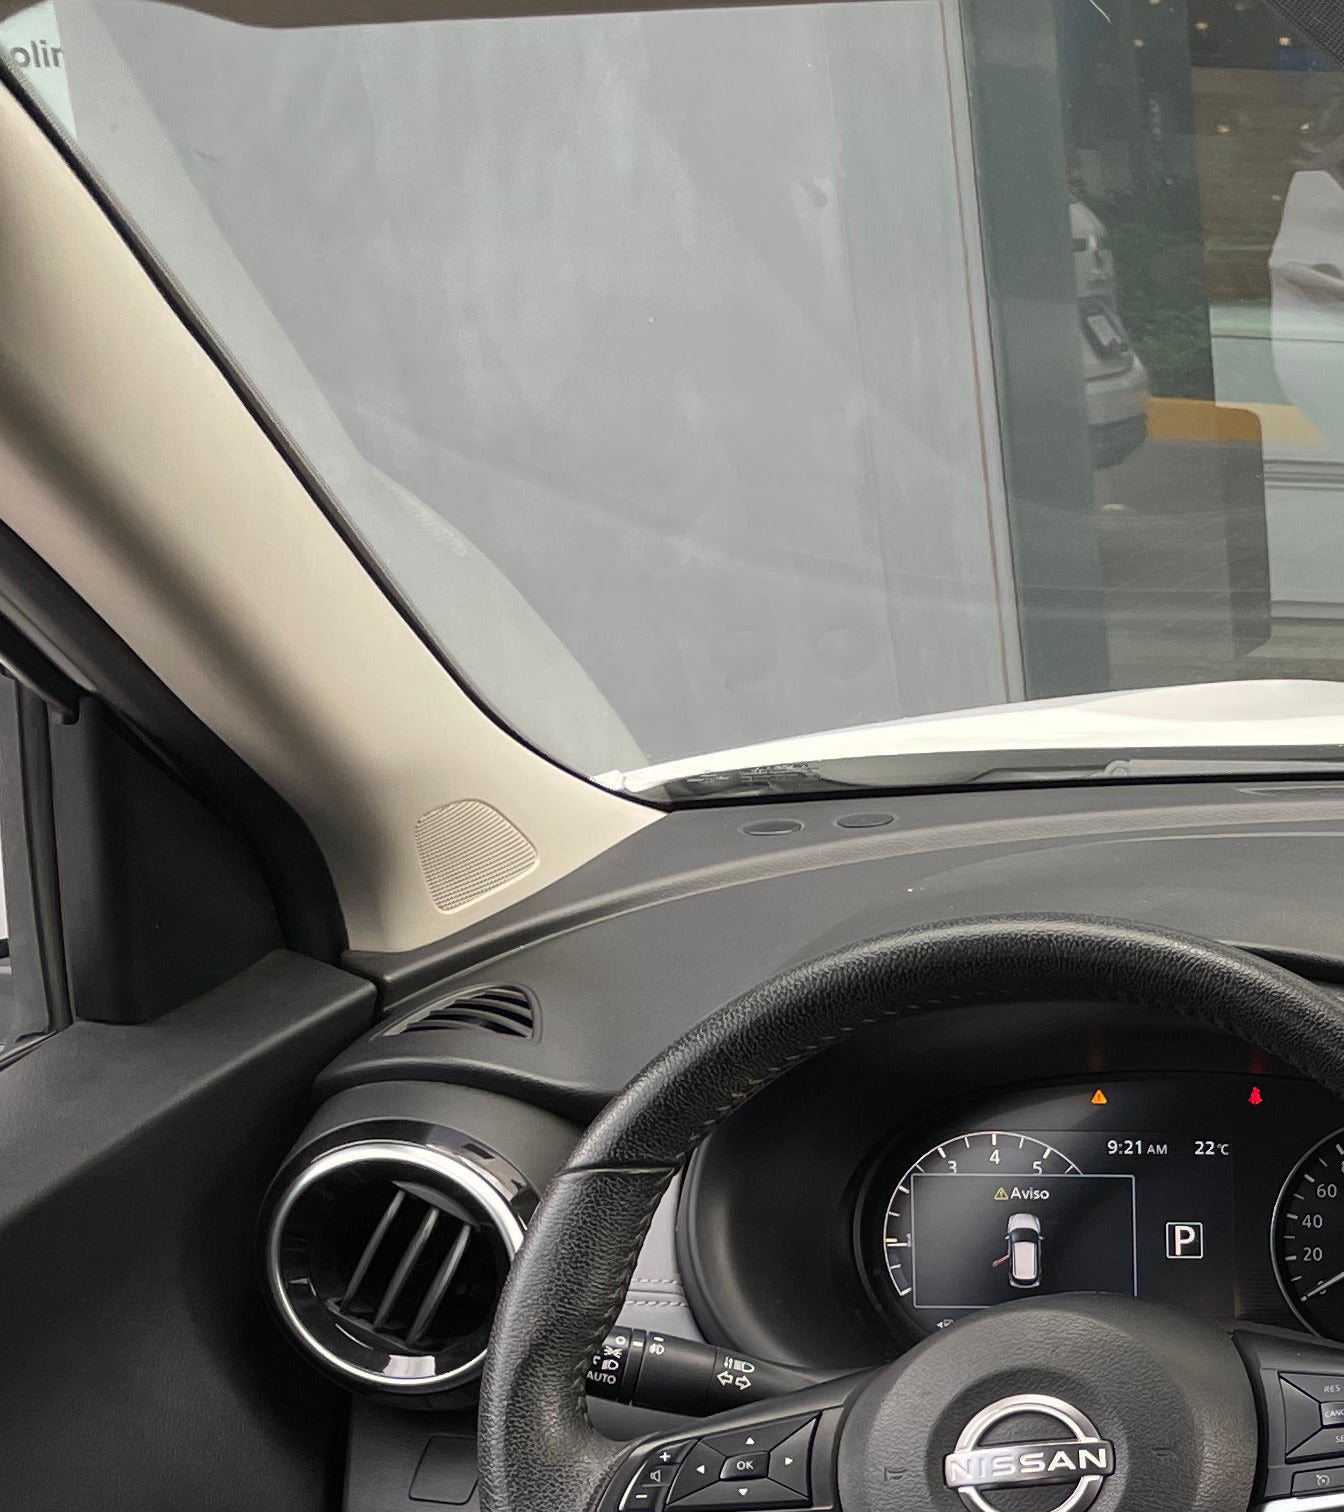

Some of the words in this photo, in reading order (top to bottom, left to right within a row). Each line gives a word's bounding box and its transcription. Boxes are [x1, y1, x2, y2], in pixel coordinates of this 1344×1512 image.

[1107, 1139, 1142, 1155] 9:21
[1146, 1144, 1168, 1155] AM
[989, 1149, 1001, 1165] 4
[947, 1160, 958, 1174] 3
[1032, 1160, 1043, 1174] 5
[1010, 1186, 1050, 1200] Aviso
[1316, 1183, 1338, 1199] 60
[1301, 1214, 1323, 1229] 40
[1174, 1225, 1196, 1257] P
[1303, 1247, 1323, 1262] 20
[586, 1370, 617, 1385] AUTO
[1323, 1384, 1341, 1393] RES
[736, 1460, 754, 1471] OK
[950, 1447, 1107, 1481] NISSAN
